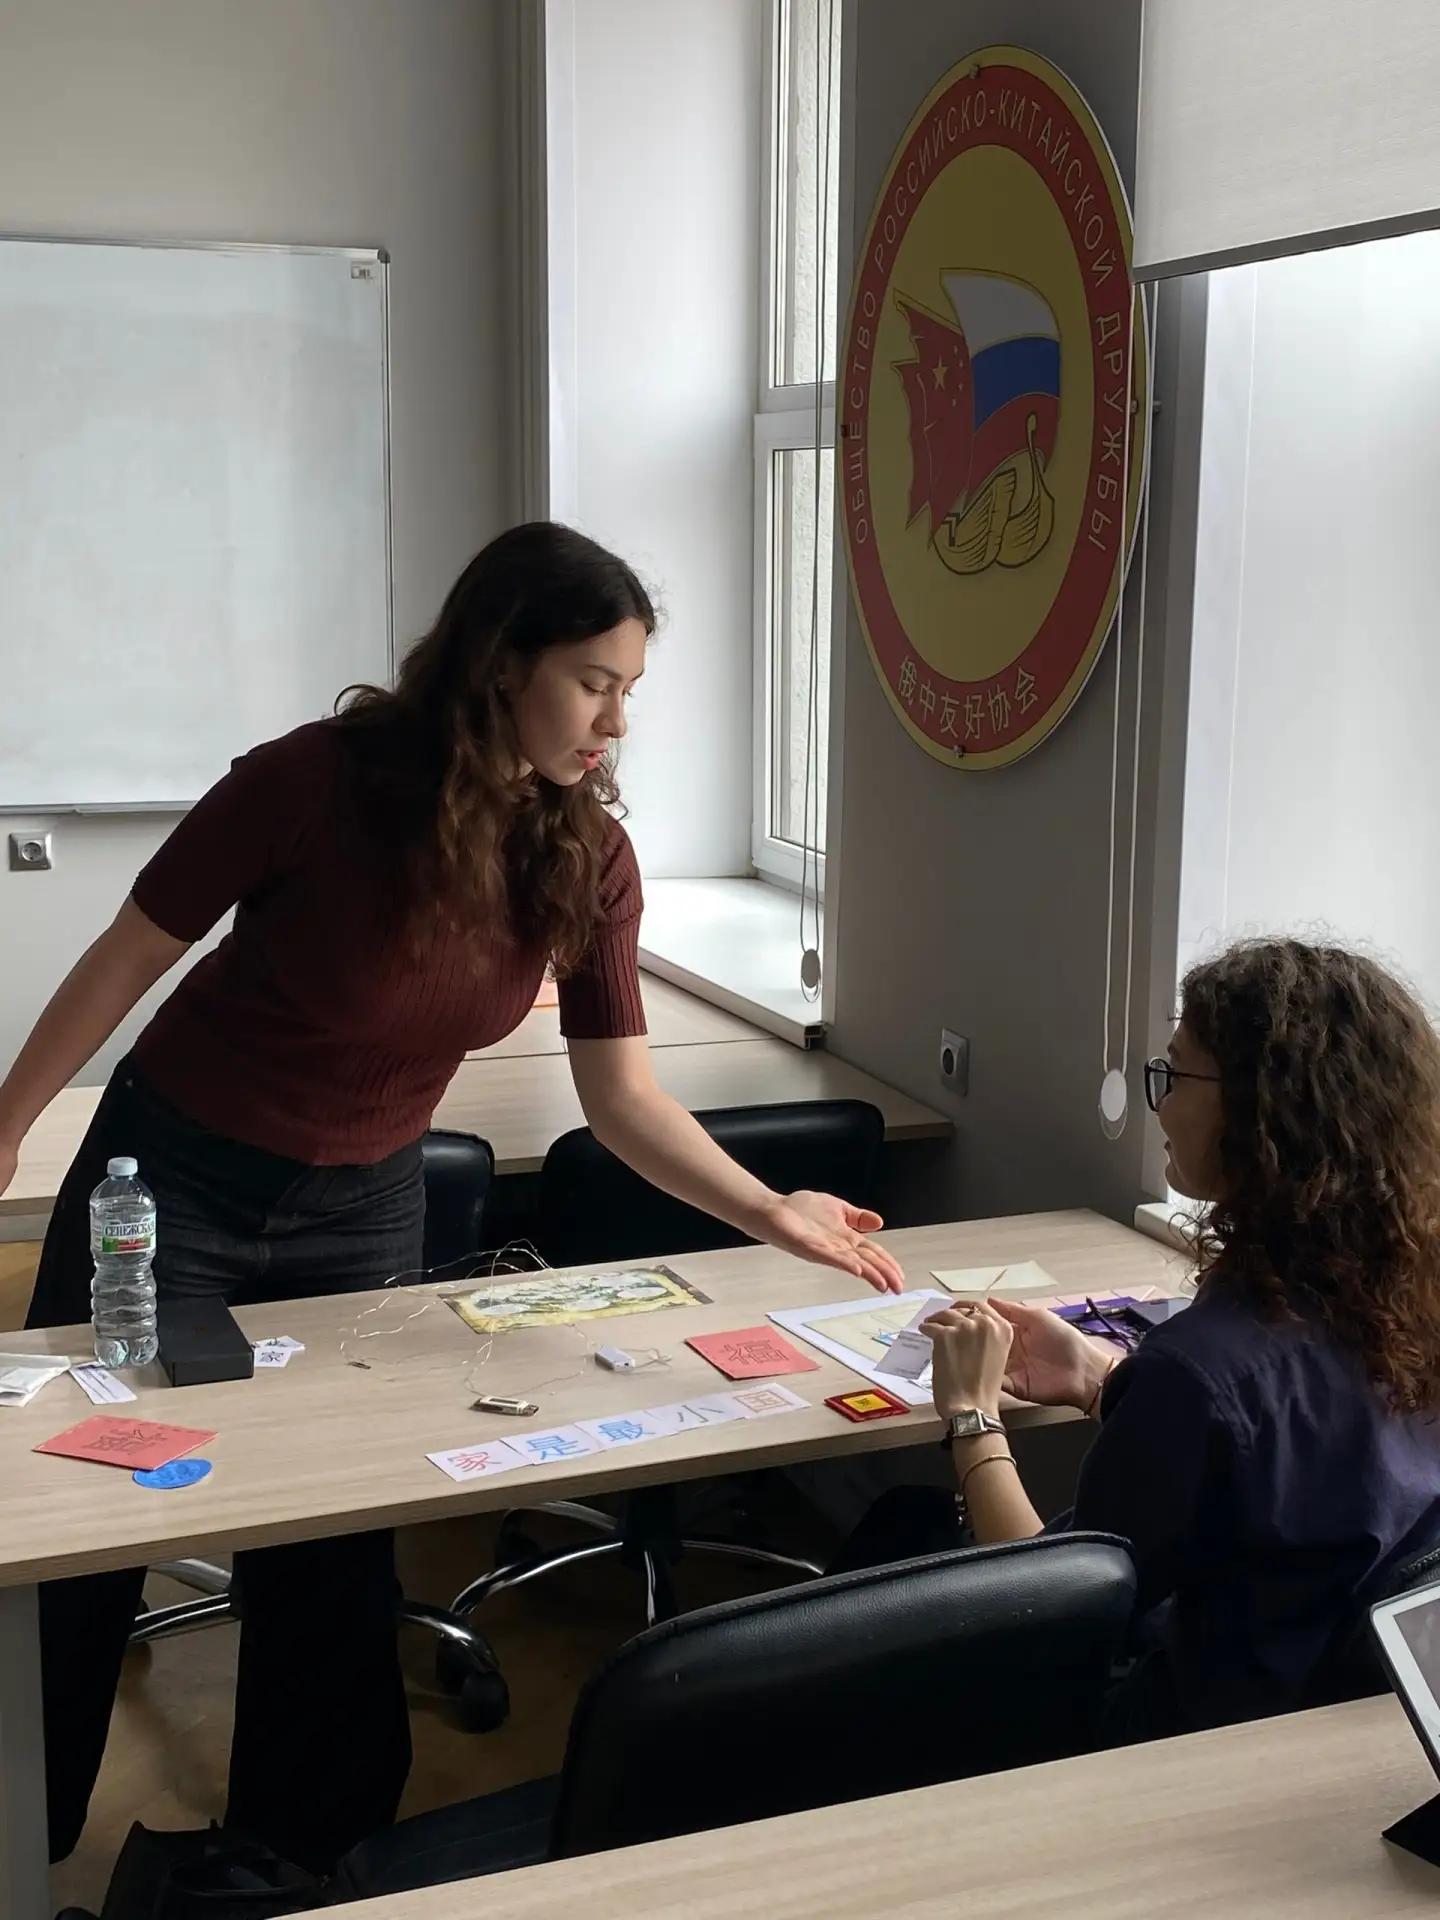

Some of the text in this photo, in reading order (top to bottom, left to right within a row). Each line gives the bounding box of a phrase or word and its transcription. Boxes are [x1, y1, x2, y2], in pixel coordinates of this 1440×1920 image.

[851, 88, 1124, 551] ОБЩЕСТВО РОССИЙСКО-КИТАЙСКОЙ ДРУЖБЫ
[898, 655, 1038, 740] 俄中友好协会
